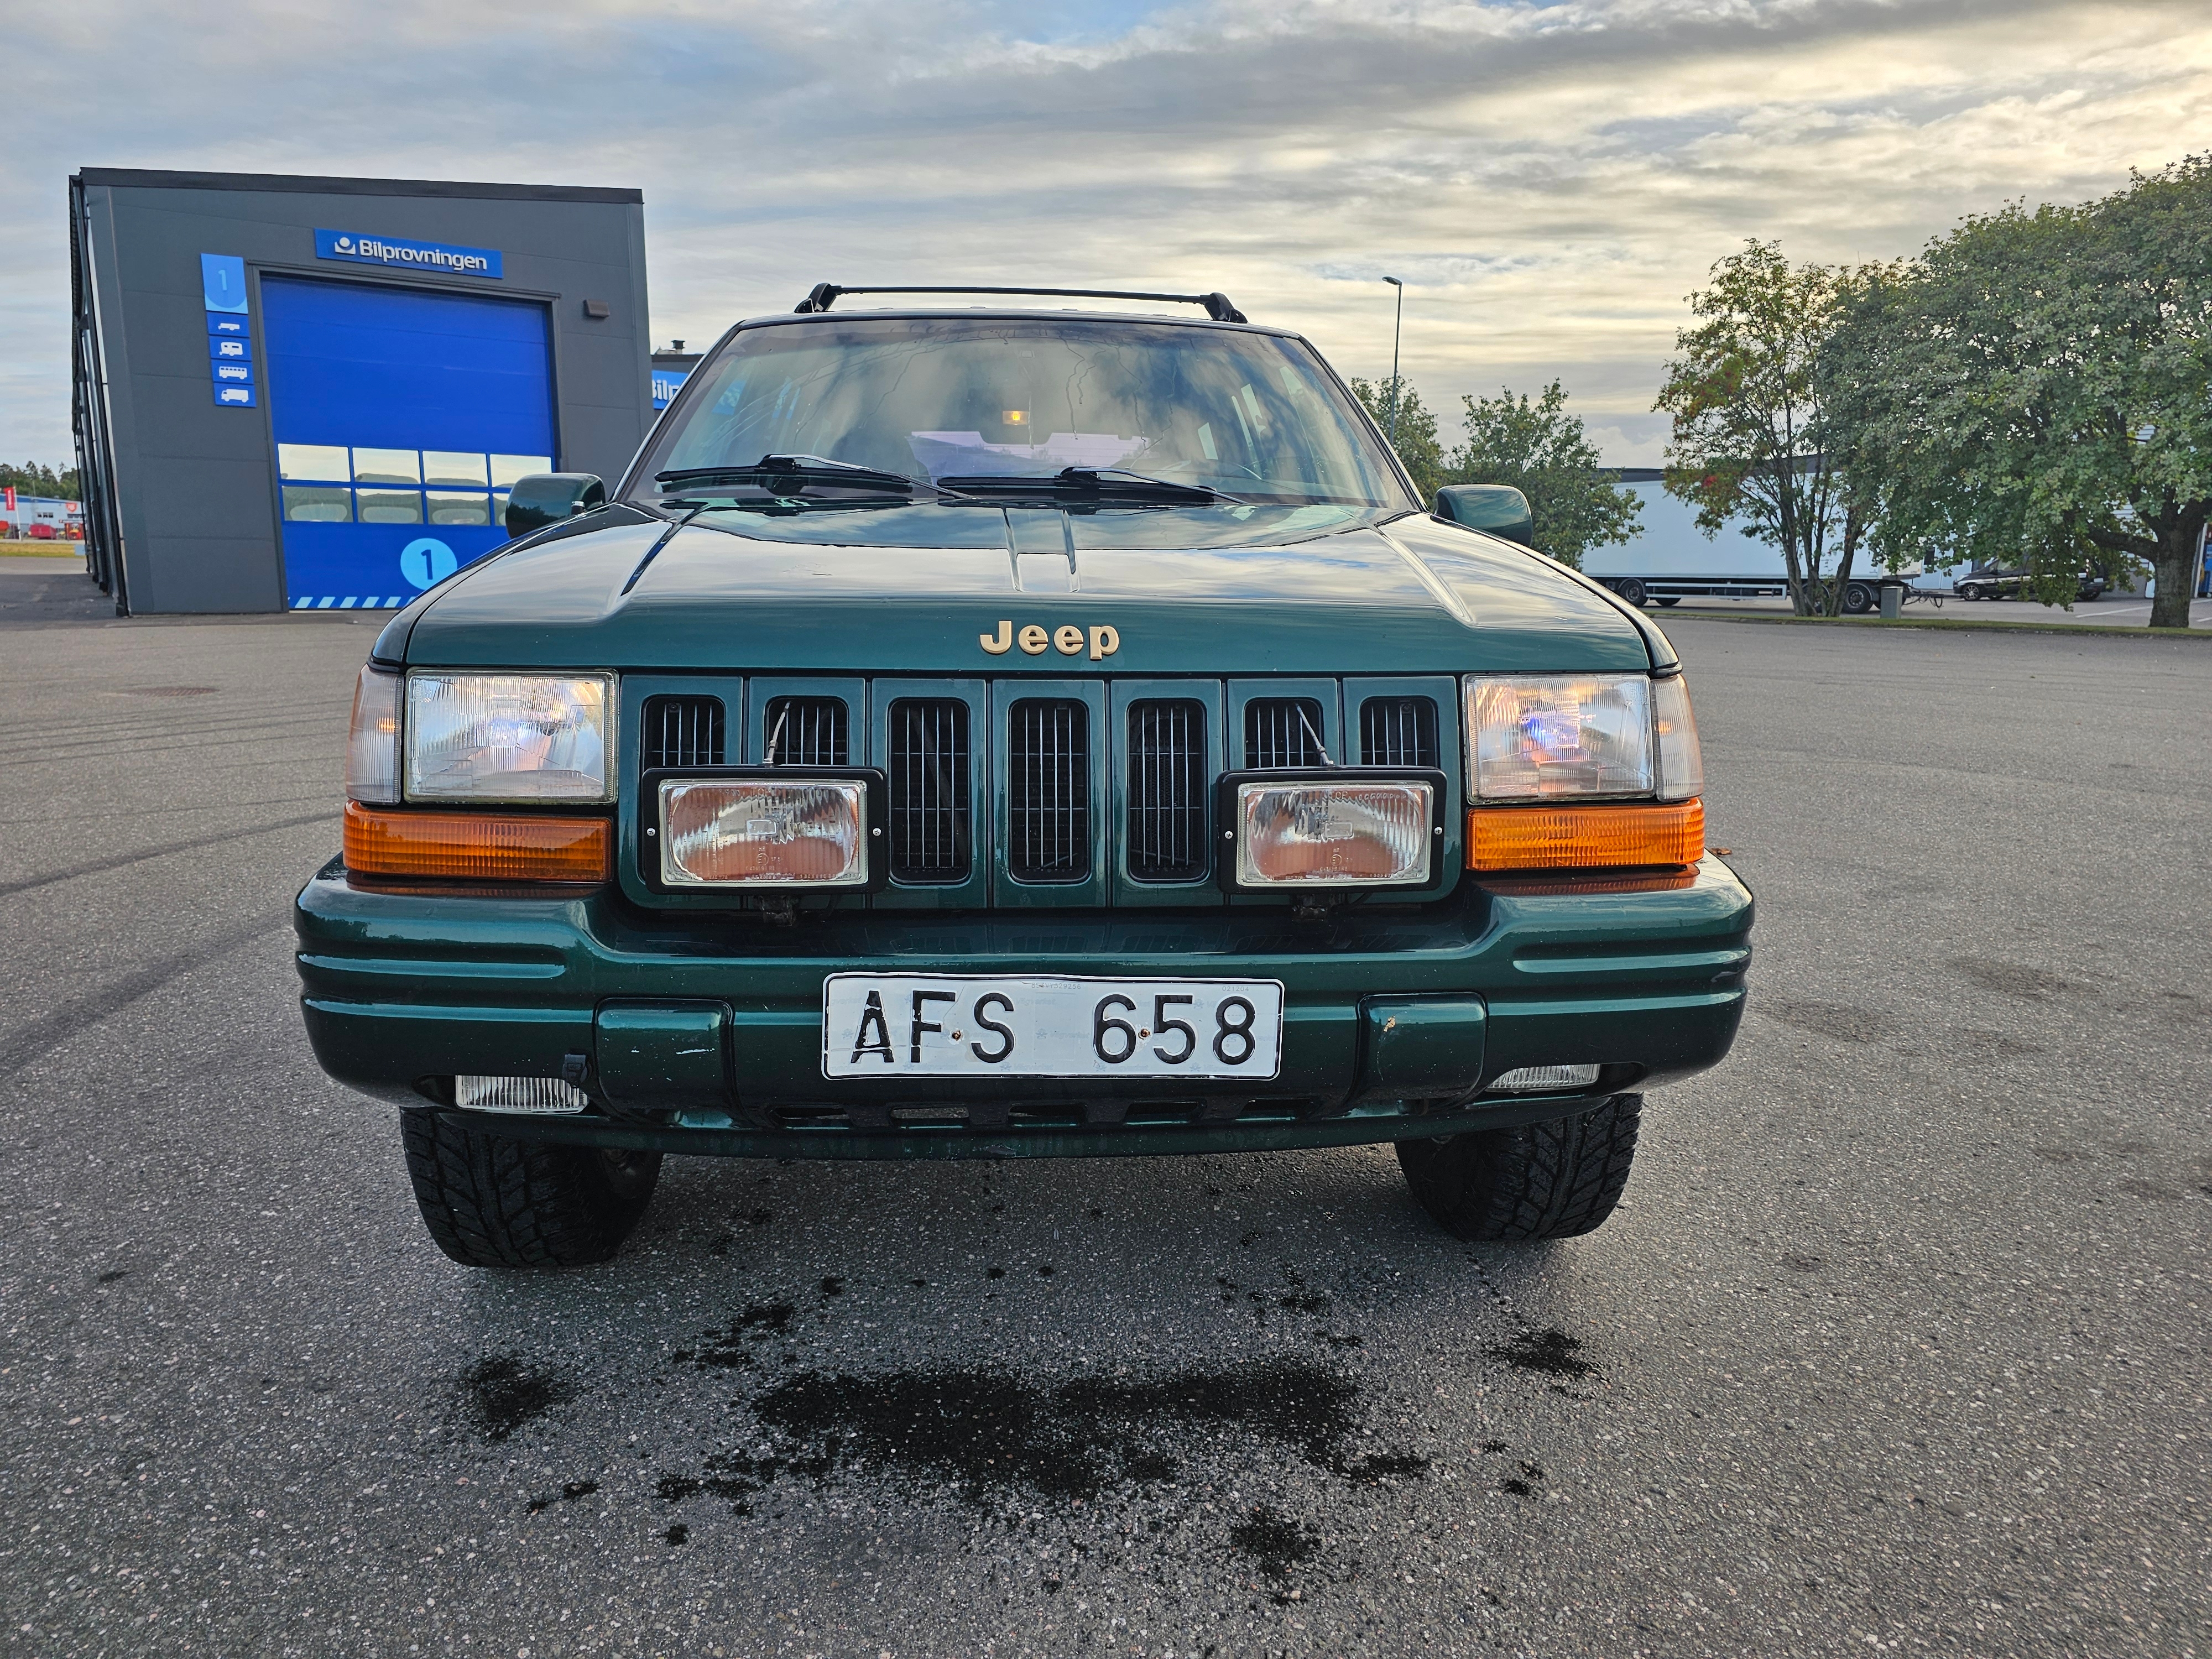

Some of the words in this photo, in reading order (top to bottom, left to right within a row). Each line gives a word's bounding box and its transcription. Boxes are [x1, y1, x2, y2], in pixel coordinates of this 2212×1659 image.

[359, 239, 487, 271] Bilprovningen
[217, 269, 227, 291] 1
[421, 549, 433, 580] 1
[979, 620, 1120, 660] Jeep
[851, 990, 1014, 1064] AFS
[1093, 994, 1255, 1065] 658
